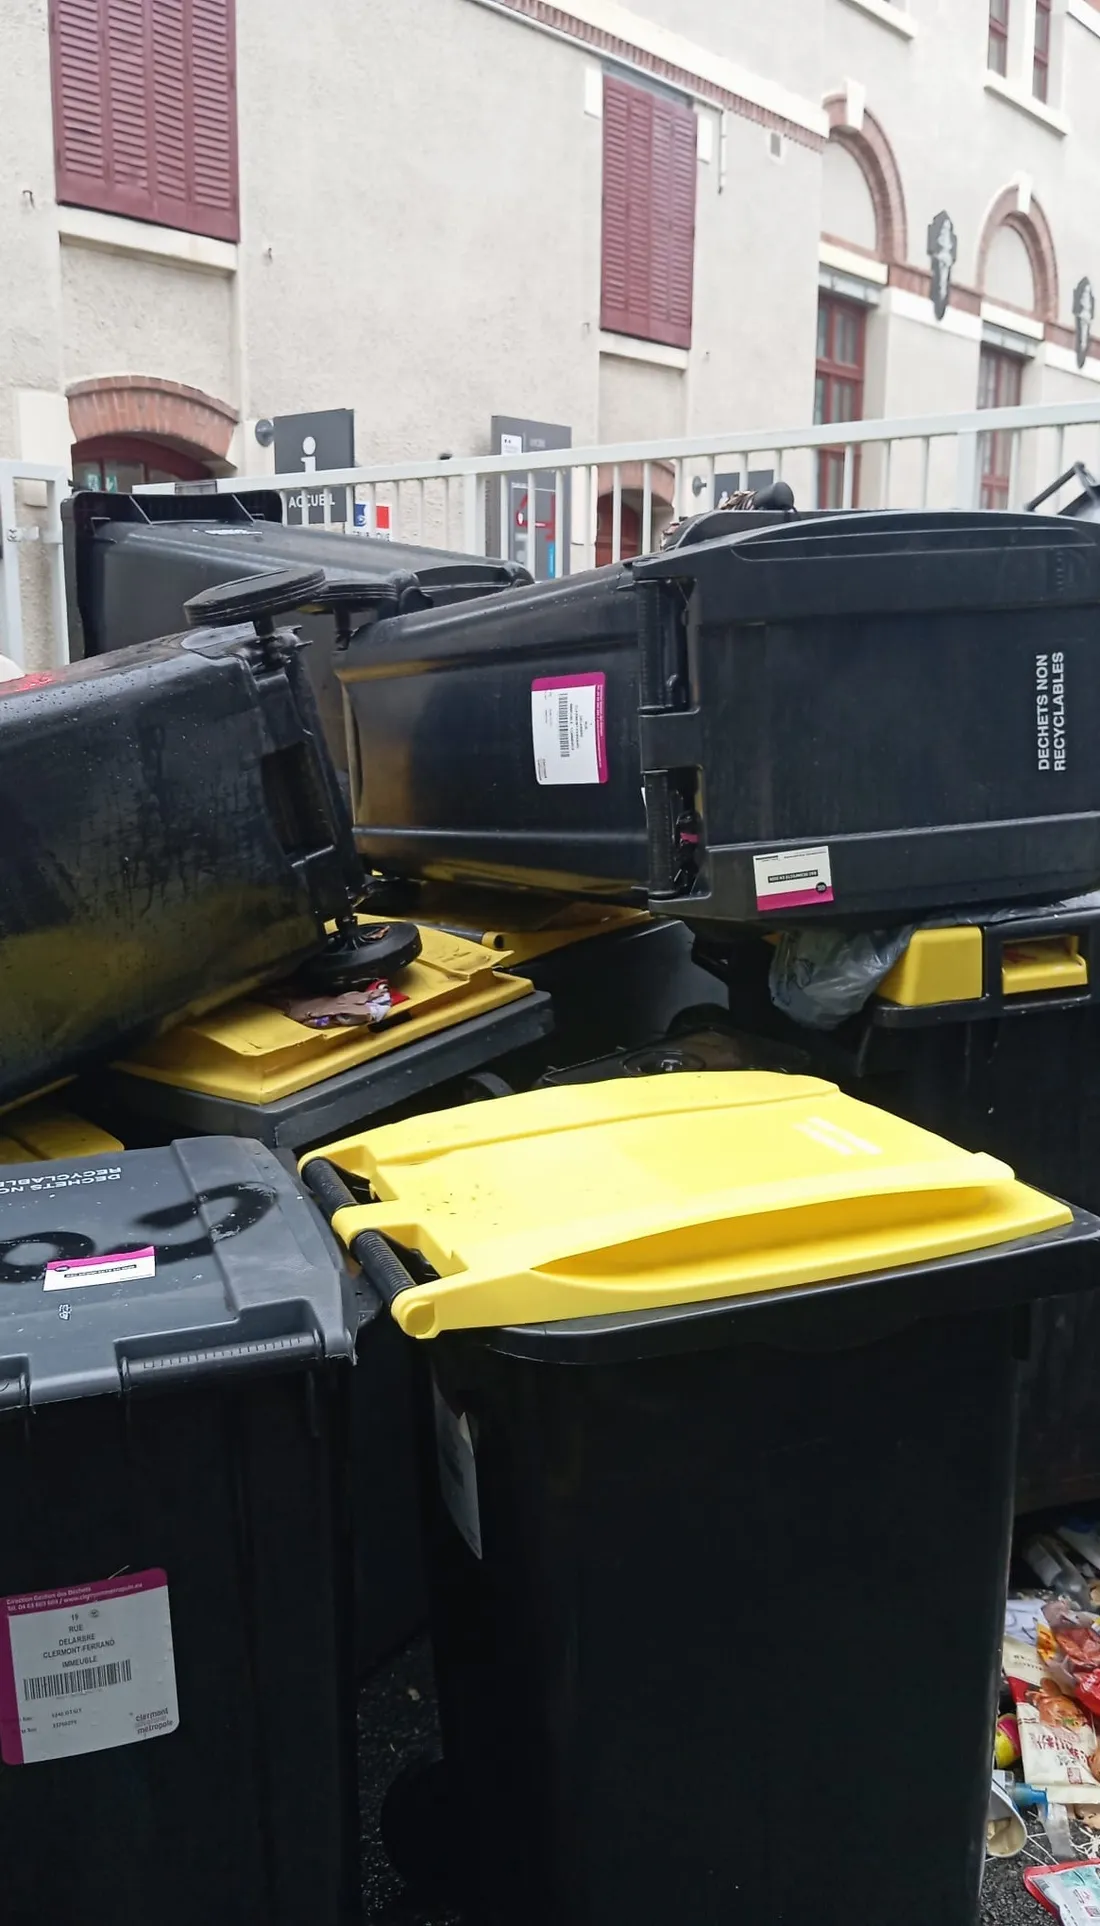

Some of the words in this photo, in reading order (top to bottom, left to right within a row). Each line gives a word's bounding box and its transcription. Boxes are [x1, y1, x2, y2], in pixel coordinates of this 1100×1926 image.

[288, 493, 336, 508] ACUEL
[1035, 654, 1049, 691] NON
[1052, 652, 1066, 771] RECYCLABLES
[1036, 694, 1050, 771] DECHETS
[0, 1167, 122, 1187] RECYCLABL
[30, 1174, 121, 1191] DECHETS
[0, 1186, 24, 1194] NO
[68, 1624, 84, 1632] RUE
